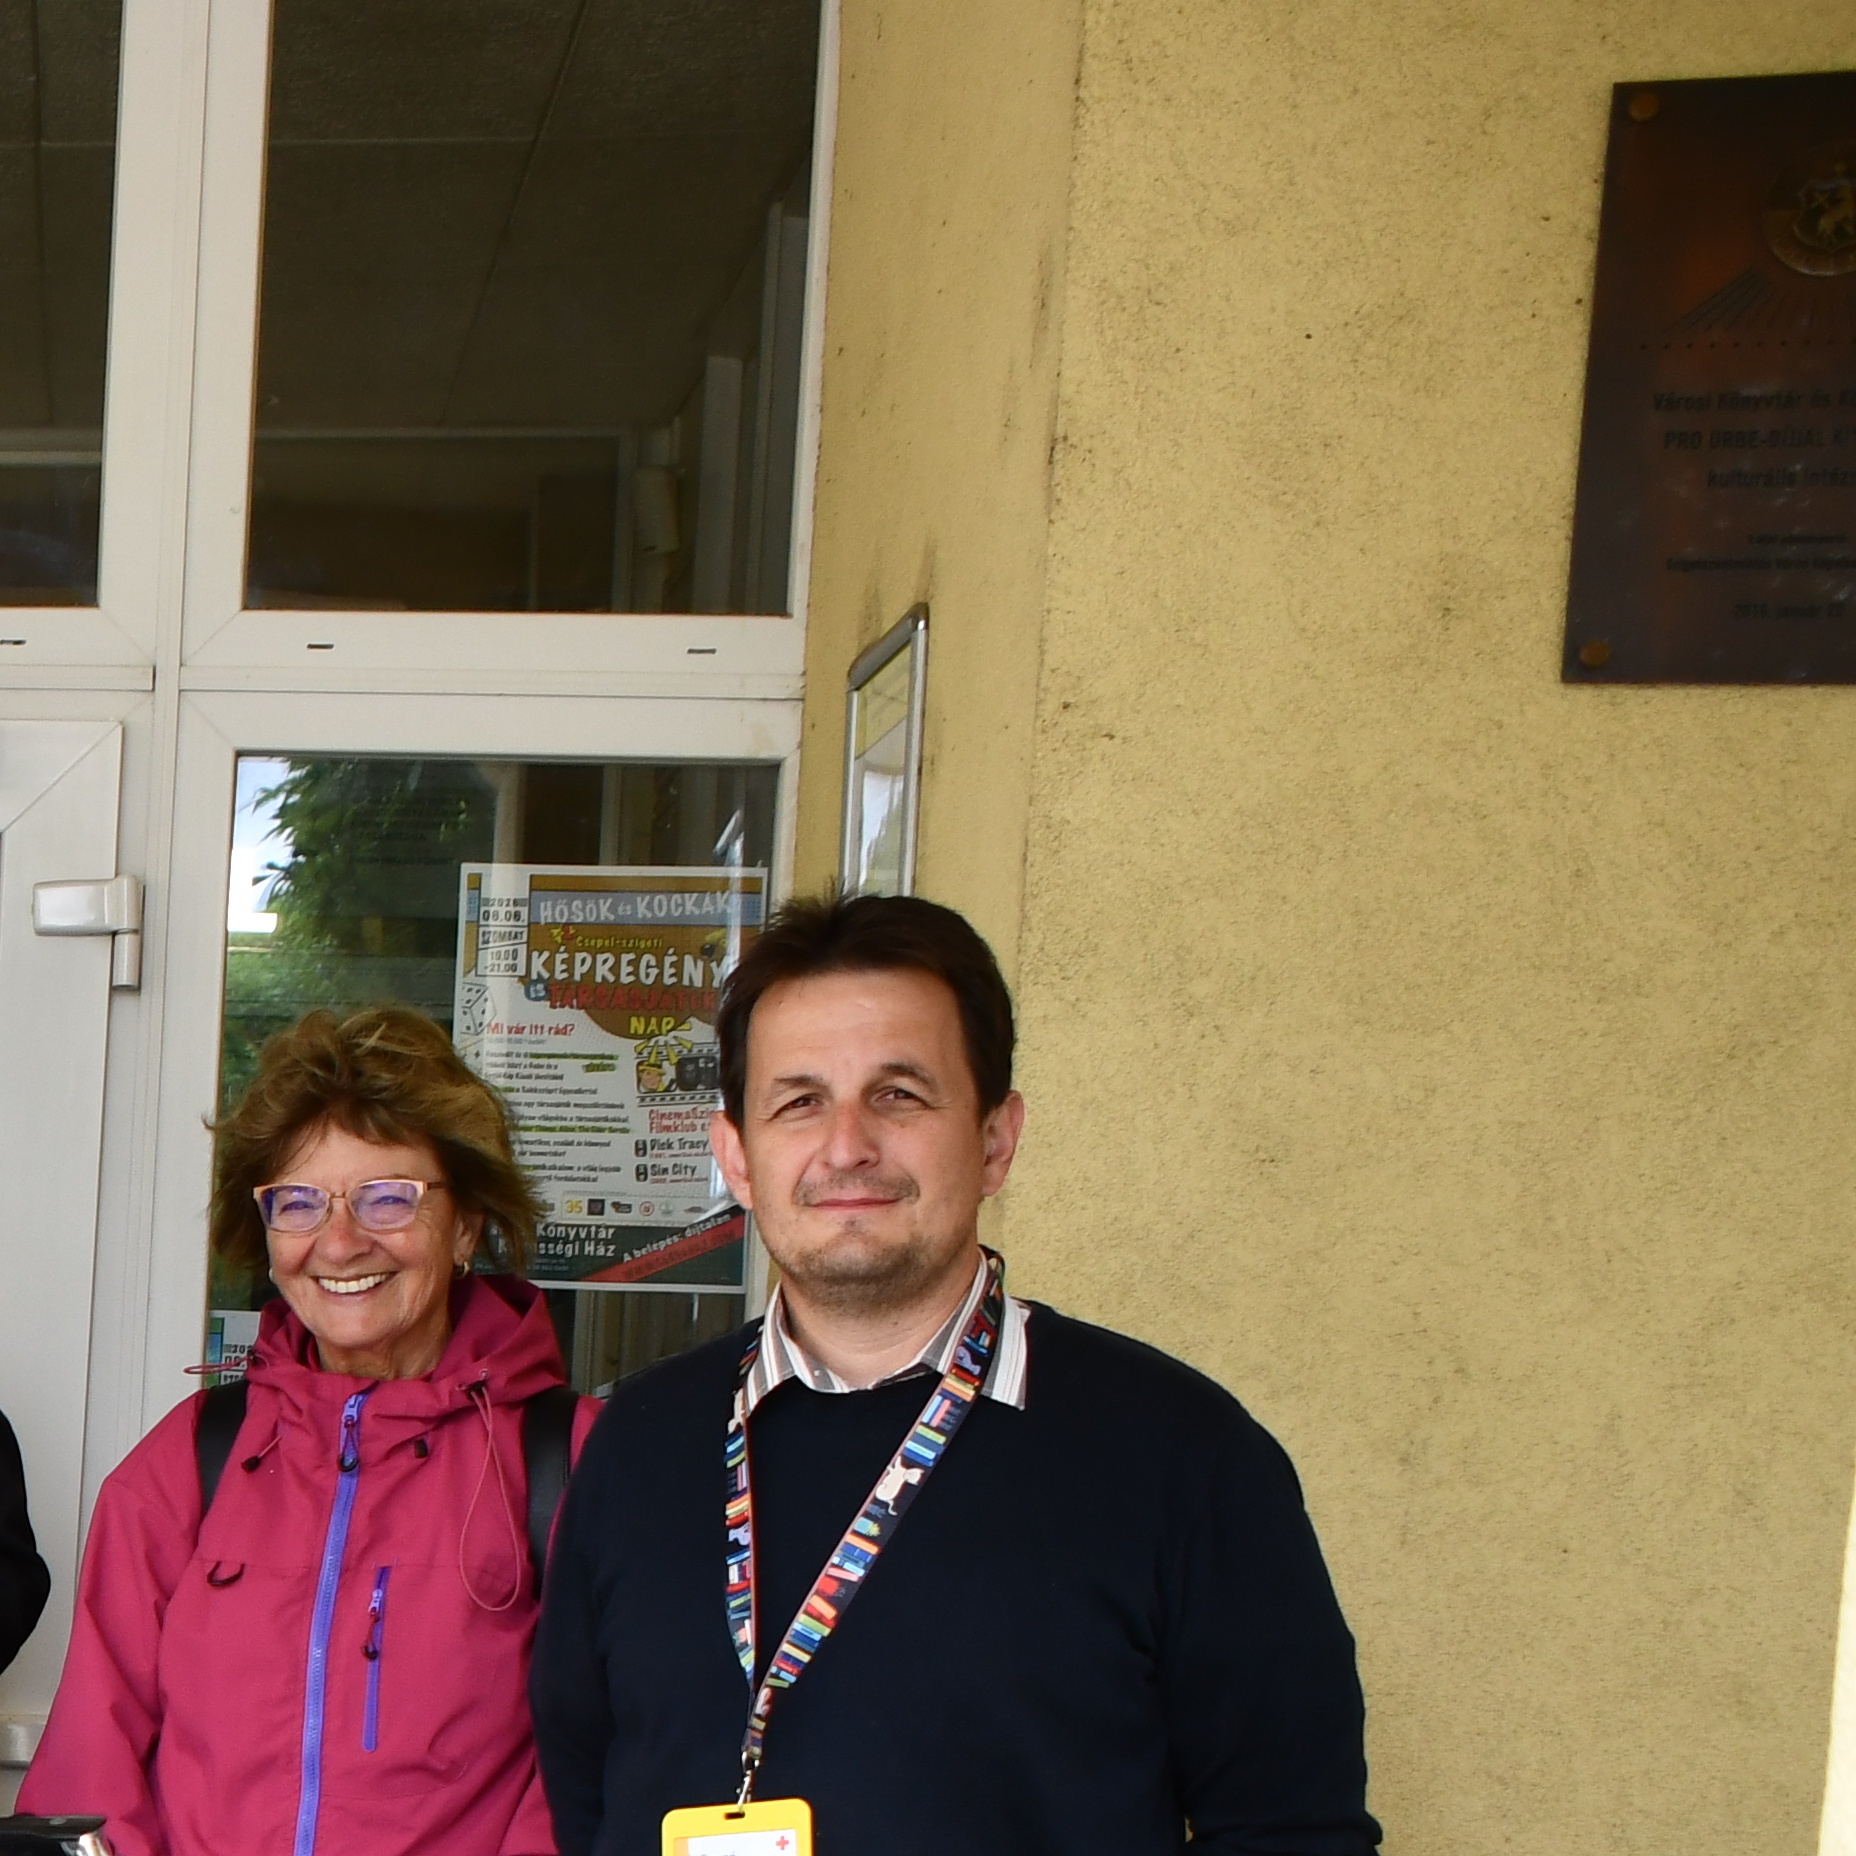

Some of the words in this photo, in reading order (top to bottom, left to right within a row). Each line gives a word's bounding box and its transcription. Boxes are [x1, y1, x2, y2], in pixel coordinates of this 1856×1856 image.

[1654, 391, 1711, 411] Városi
[1664, 430, 1703, 449] PRO
[530, 946, 728, 990] KÉPREGÉNY
[629, 1015, 675, 1036] NAP
[584, 1241, 617, 1258] Ház
